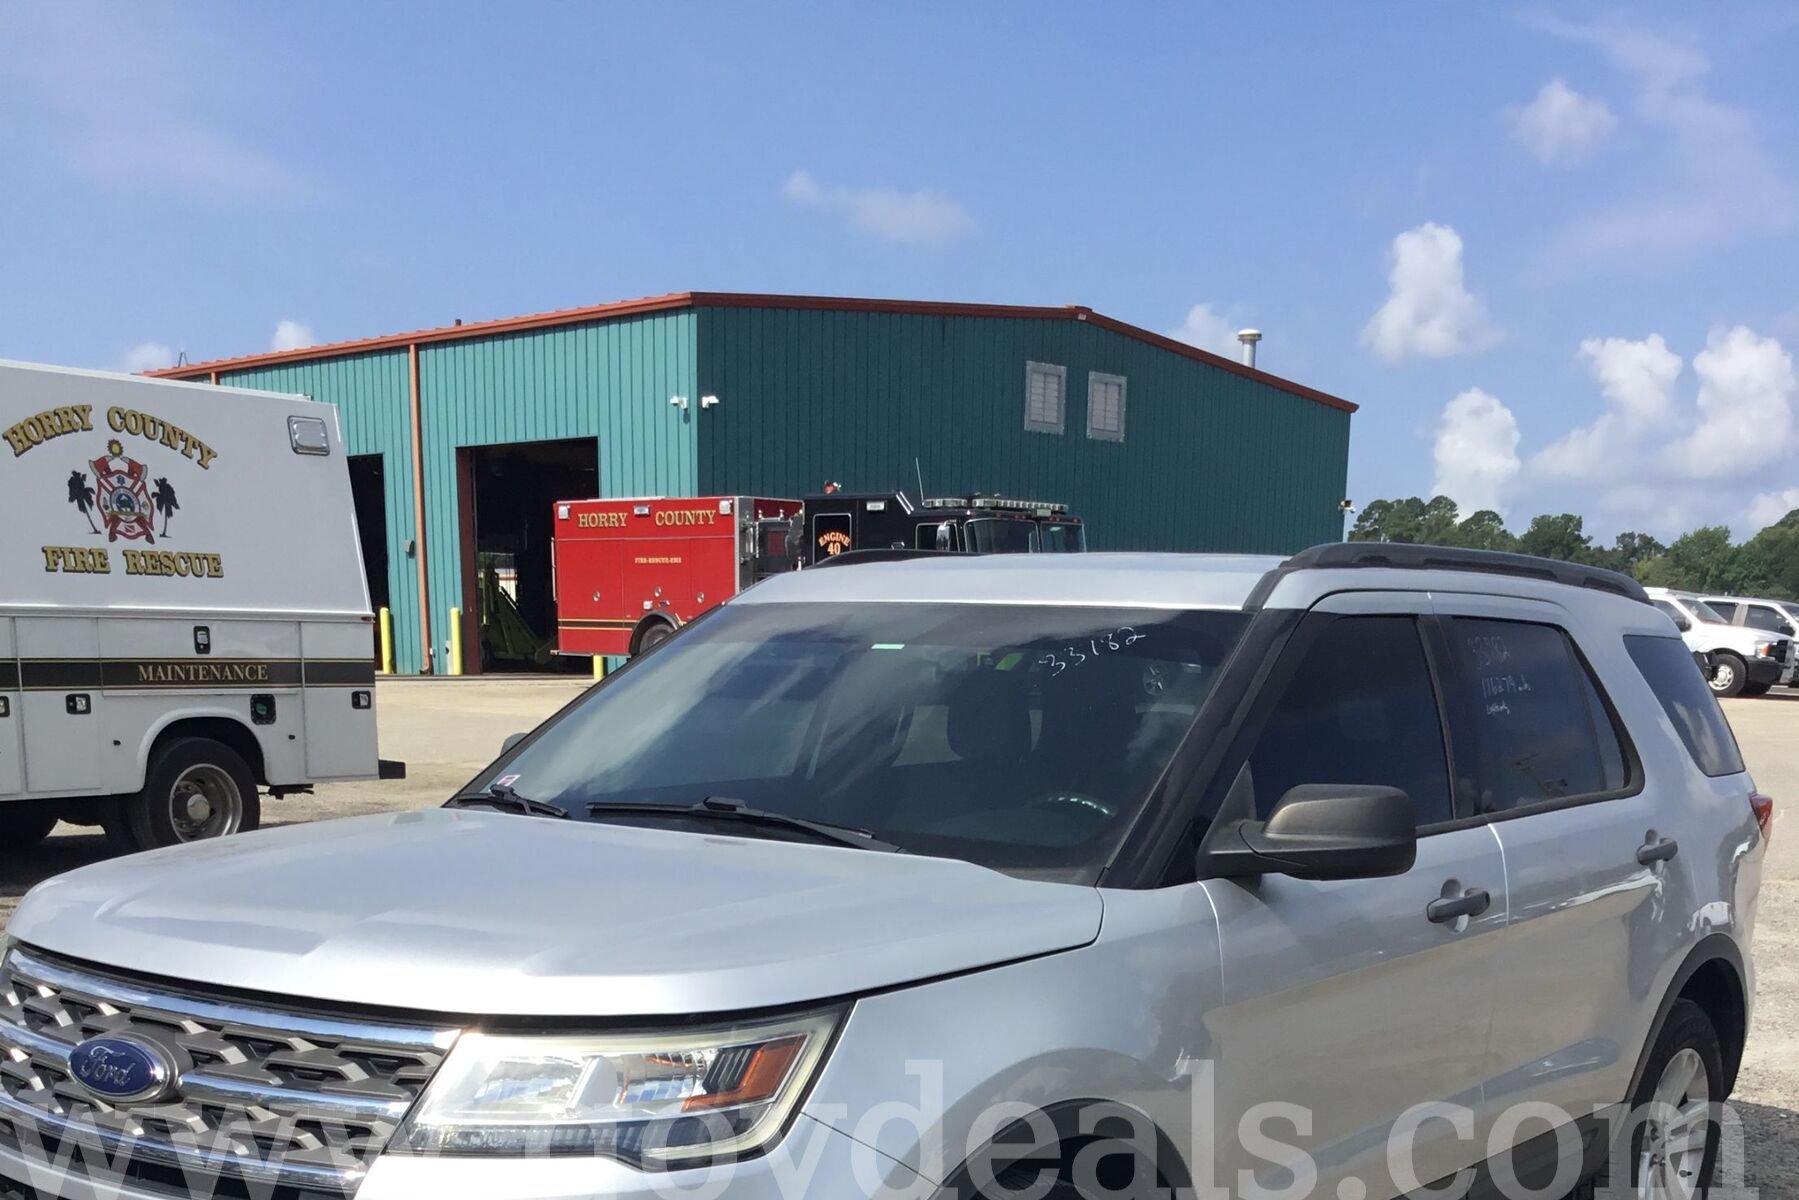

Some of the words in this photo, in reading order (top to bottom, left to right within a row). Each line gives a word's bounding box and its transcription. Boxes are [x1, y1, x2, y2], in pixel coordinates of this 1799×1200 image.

[2, 405, 93, 457] HORRY
[107, 406, 218, 470] COUNTY
[578, 513, 628, 528] HORRY
[655, 510, 716, 526] COUNTY
[818, 531, 851, 547] ENGINE
[827, 542, 841, 555] 40
[42, 546, 110, 573] FIRE
[123, 550, 224, 578] RESCUE
[138, 664, 269, 681] MAINTENANCE
[80, 1045, 136, 1086] Ford
